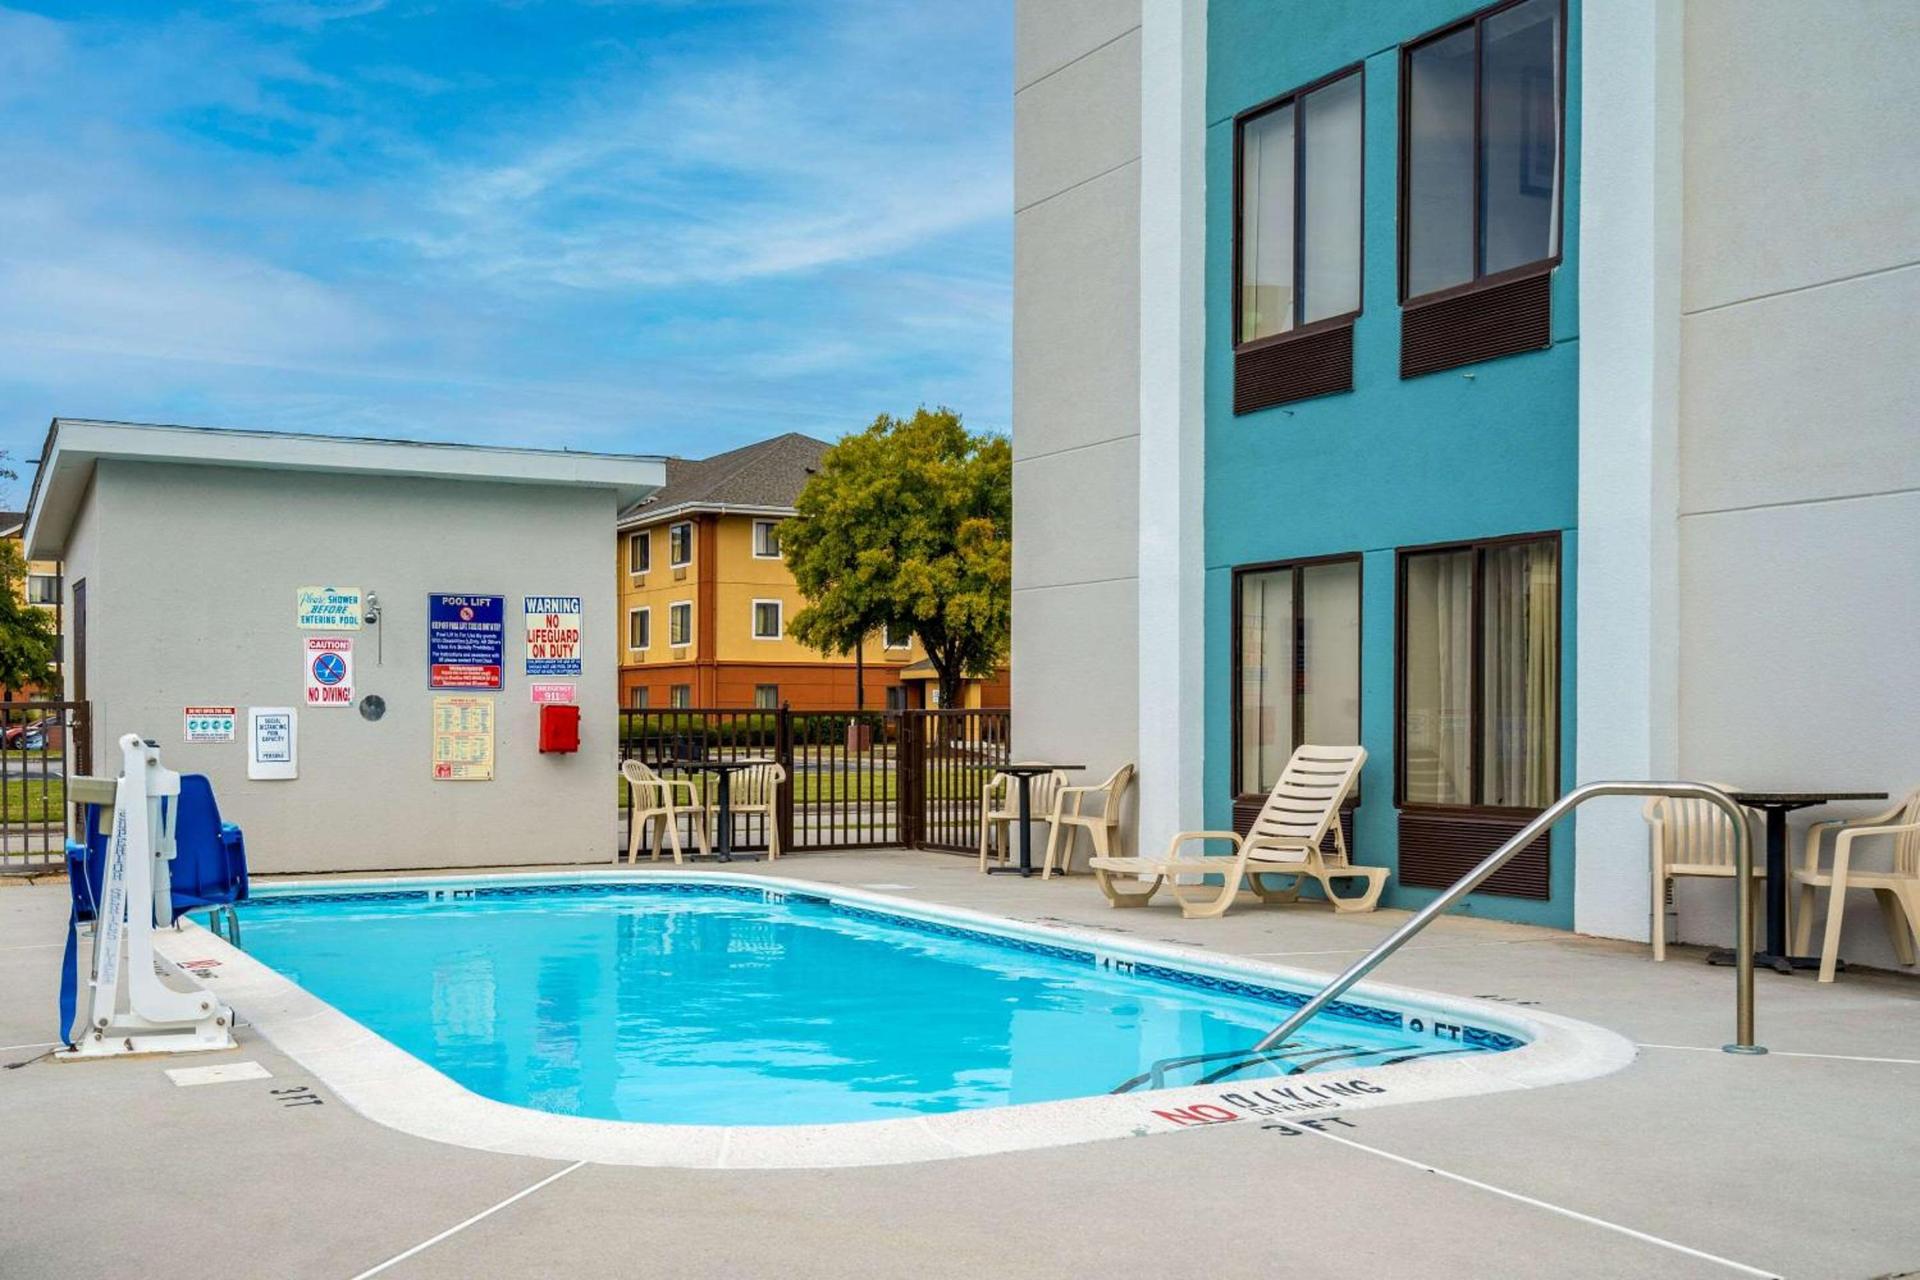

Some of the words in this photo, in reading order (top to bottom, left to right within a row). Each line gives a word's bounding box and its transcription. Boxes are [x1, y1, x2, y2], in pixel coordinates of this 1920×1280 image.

[328, 596, 358, 604] SHOWER
[442, 597, 468, 606] POOL
[470, 598, 491, 607] LIFT
[527, 598, 579, 613] WARNING
[311, 605, 348, 613] BEFORE
[301, 615, 336, 624] ENTERING
[546, 614, 559, 628] NO
[528, 629, 579, 643] LIFEGUARD
[532, 644, 546, 658] ON
[550, 644, 574, 658] DUTY
[309, 688, 320, 702] NO
[322, 687, 351, 702] DIVING!
[1150, 1103, 1239, 1126] NO
[1260, 1124, 1304, 1136] 3
[1298, 1116, 1357, 1132] FT
